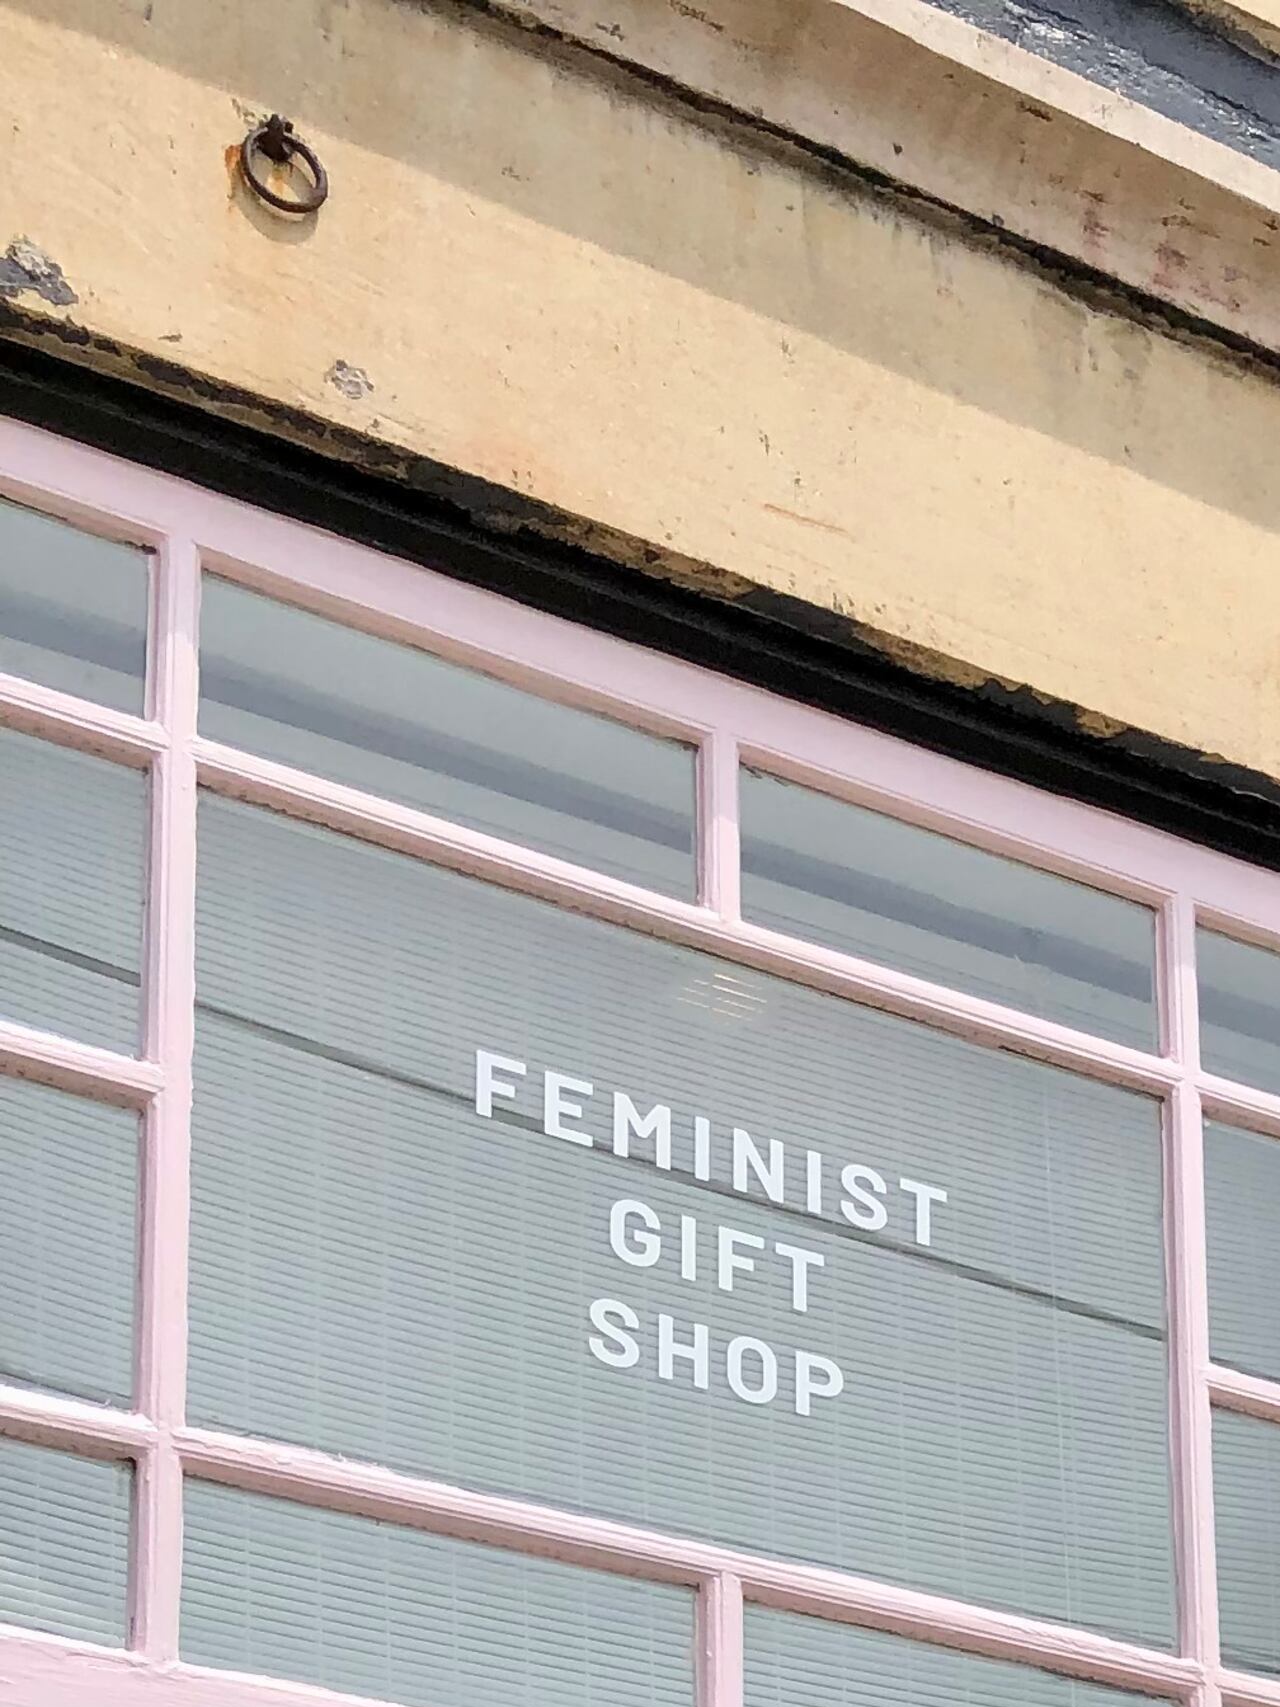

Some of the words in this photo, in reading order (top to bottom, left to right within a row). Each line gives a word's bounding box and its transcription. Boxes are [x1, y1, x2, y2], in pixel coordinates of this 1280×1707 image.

[475, 1049, 948, 1246] FEMINIST
[609, 1198, 825, 1313] GIFT
[588, 1298, 844, 1417] SHOP
